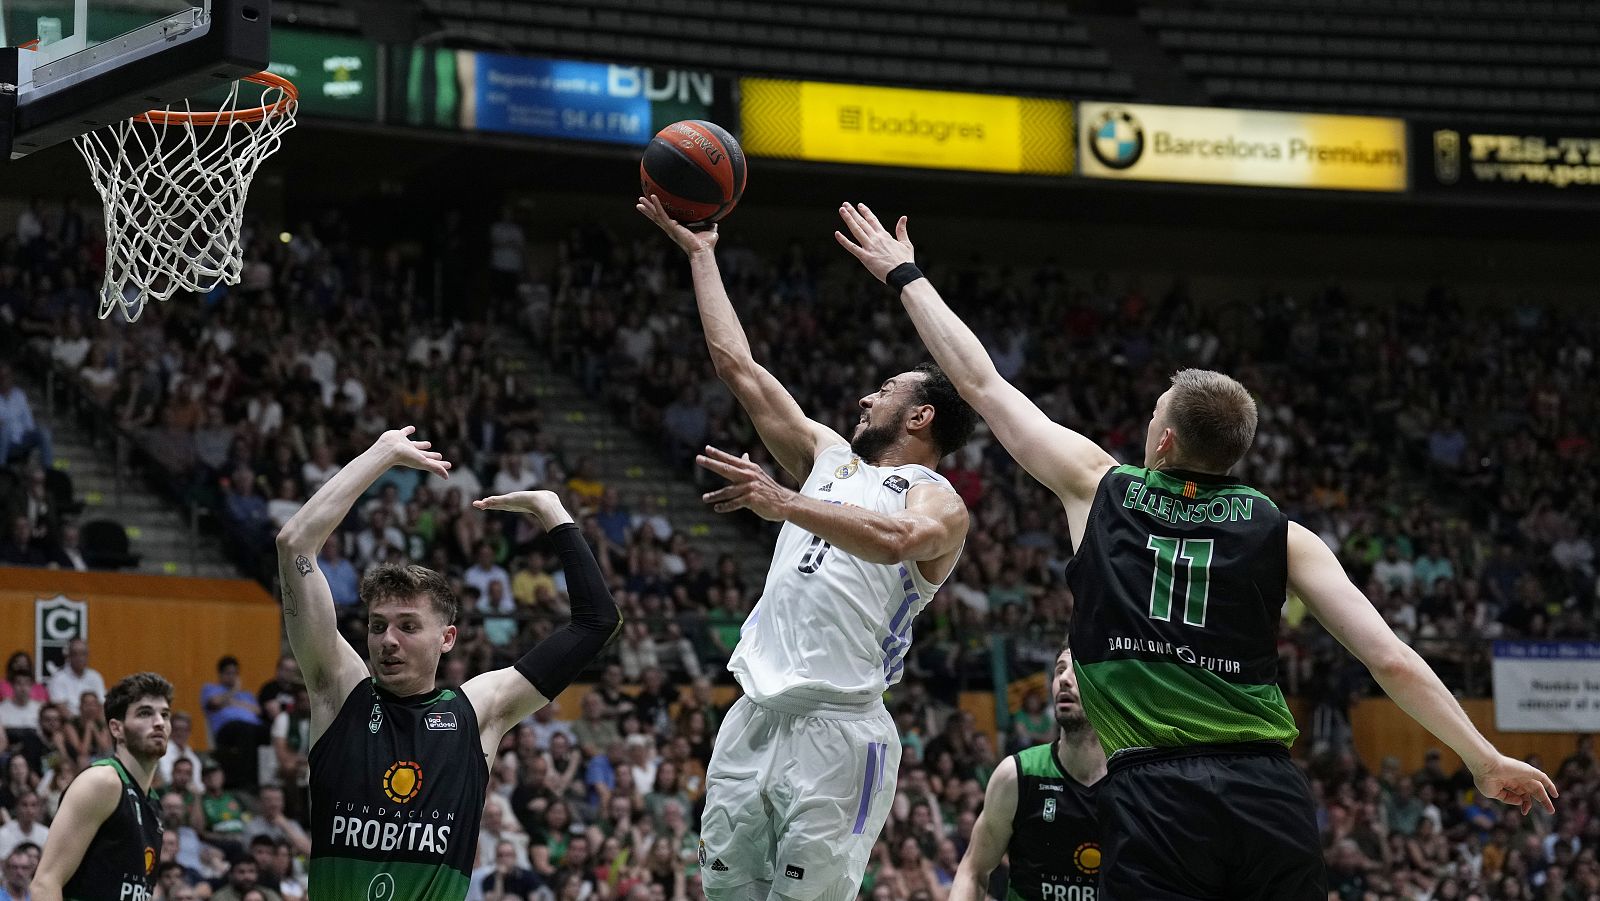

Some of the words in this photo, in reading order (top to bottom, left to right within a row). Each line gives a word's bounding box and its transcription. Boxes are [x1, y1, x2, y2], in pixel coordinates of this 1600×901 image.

[1153, 132, 1282, 160] Barcelona
[1289, 138, 1402, 167] Premium
[1122, 480, 1253, 524] ELLENSON
[1146, 533, 1215, 628] 11
[1109, 636, 1173, 655] BADALONA
[1200, 655, 1241, 674] FUTUR
[335, 801, 455, 821] FUNDACIÓN
[331, 815, 451, 855] PROBITAS
